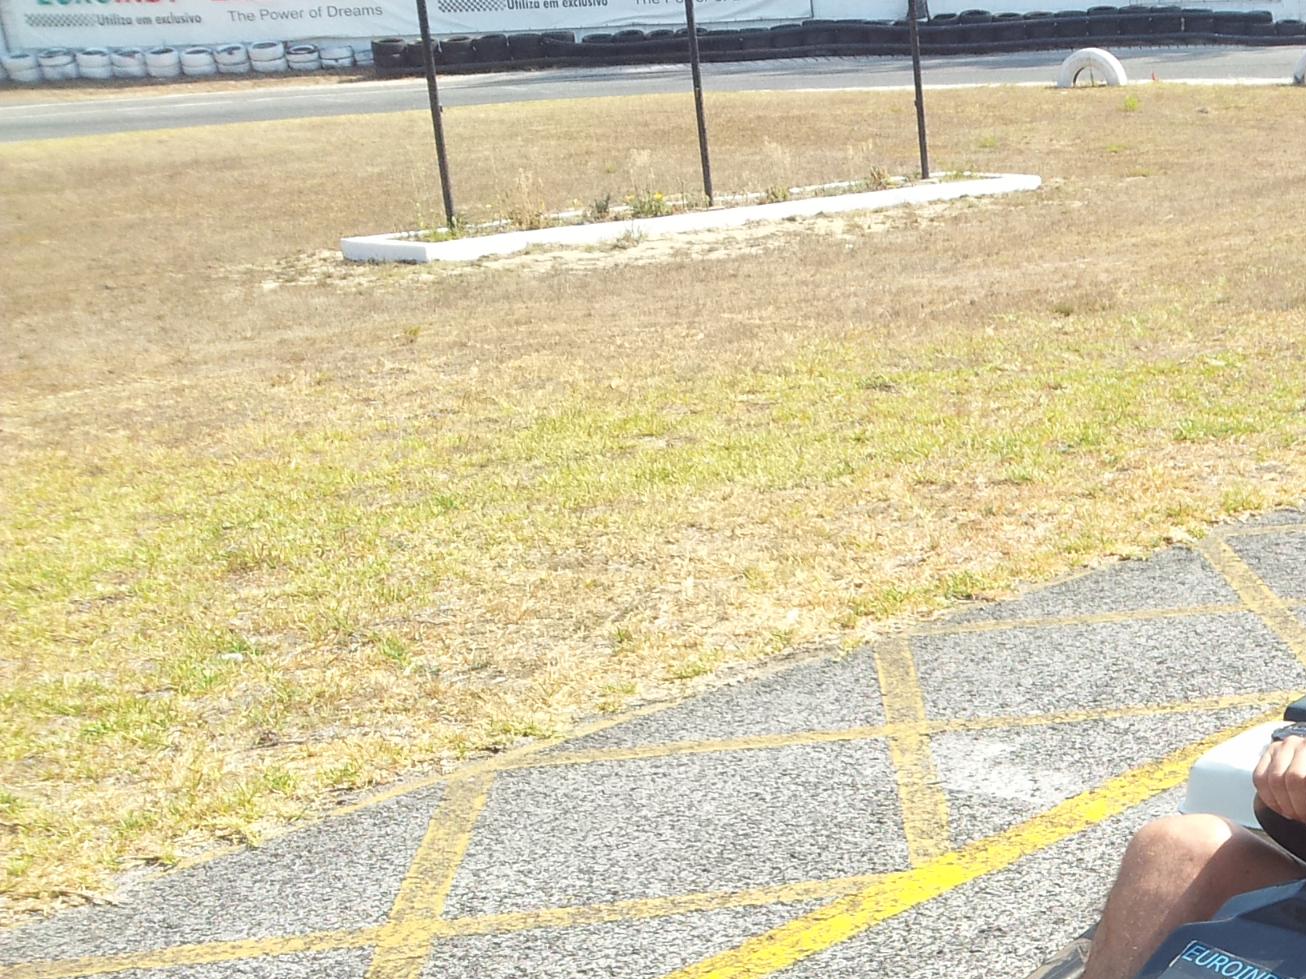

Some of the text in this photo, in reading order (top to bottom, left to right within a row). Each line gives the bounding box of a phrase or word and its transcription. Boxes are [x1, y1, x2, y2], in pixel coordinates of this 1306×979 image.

[543, 0, 559, 9] em
[97, 12, 202, 27] Utiliza em exclusivo
[227, 5, 383, 22] The Power of Dreams
